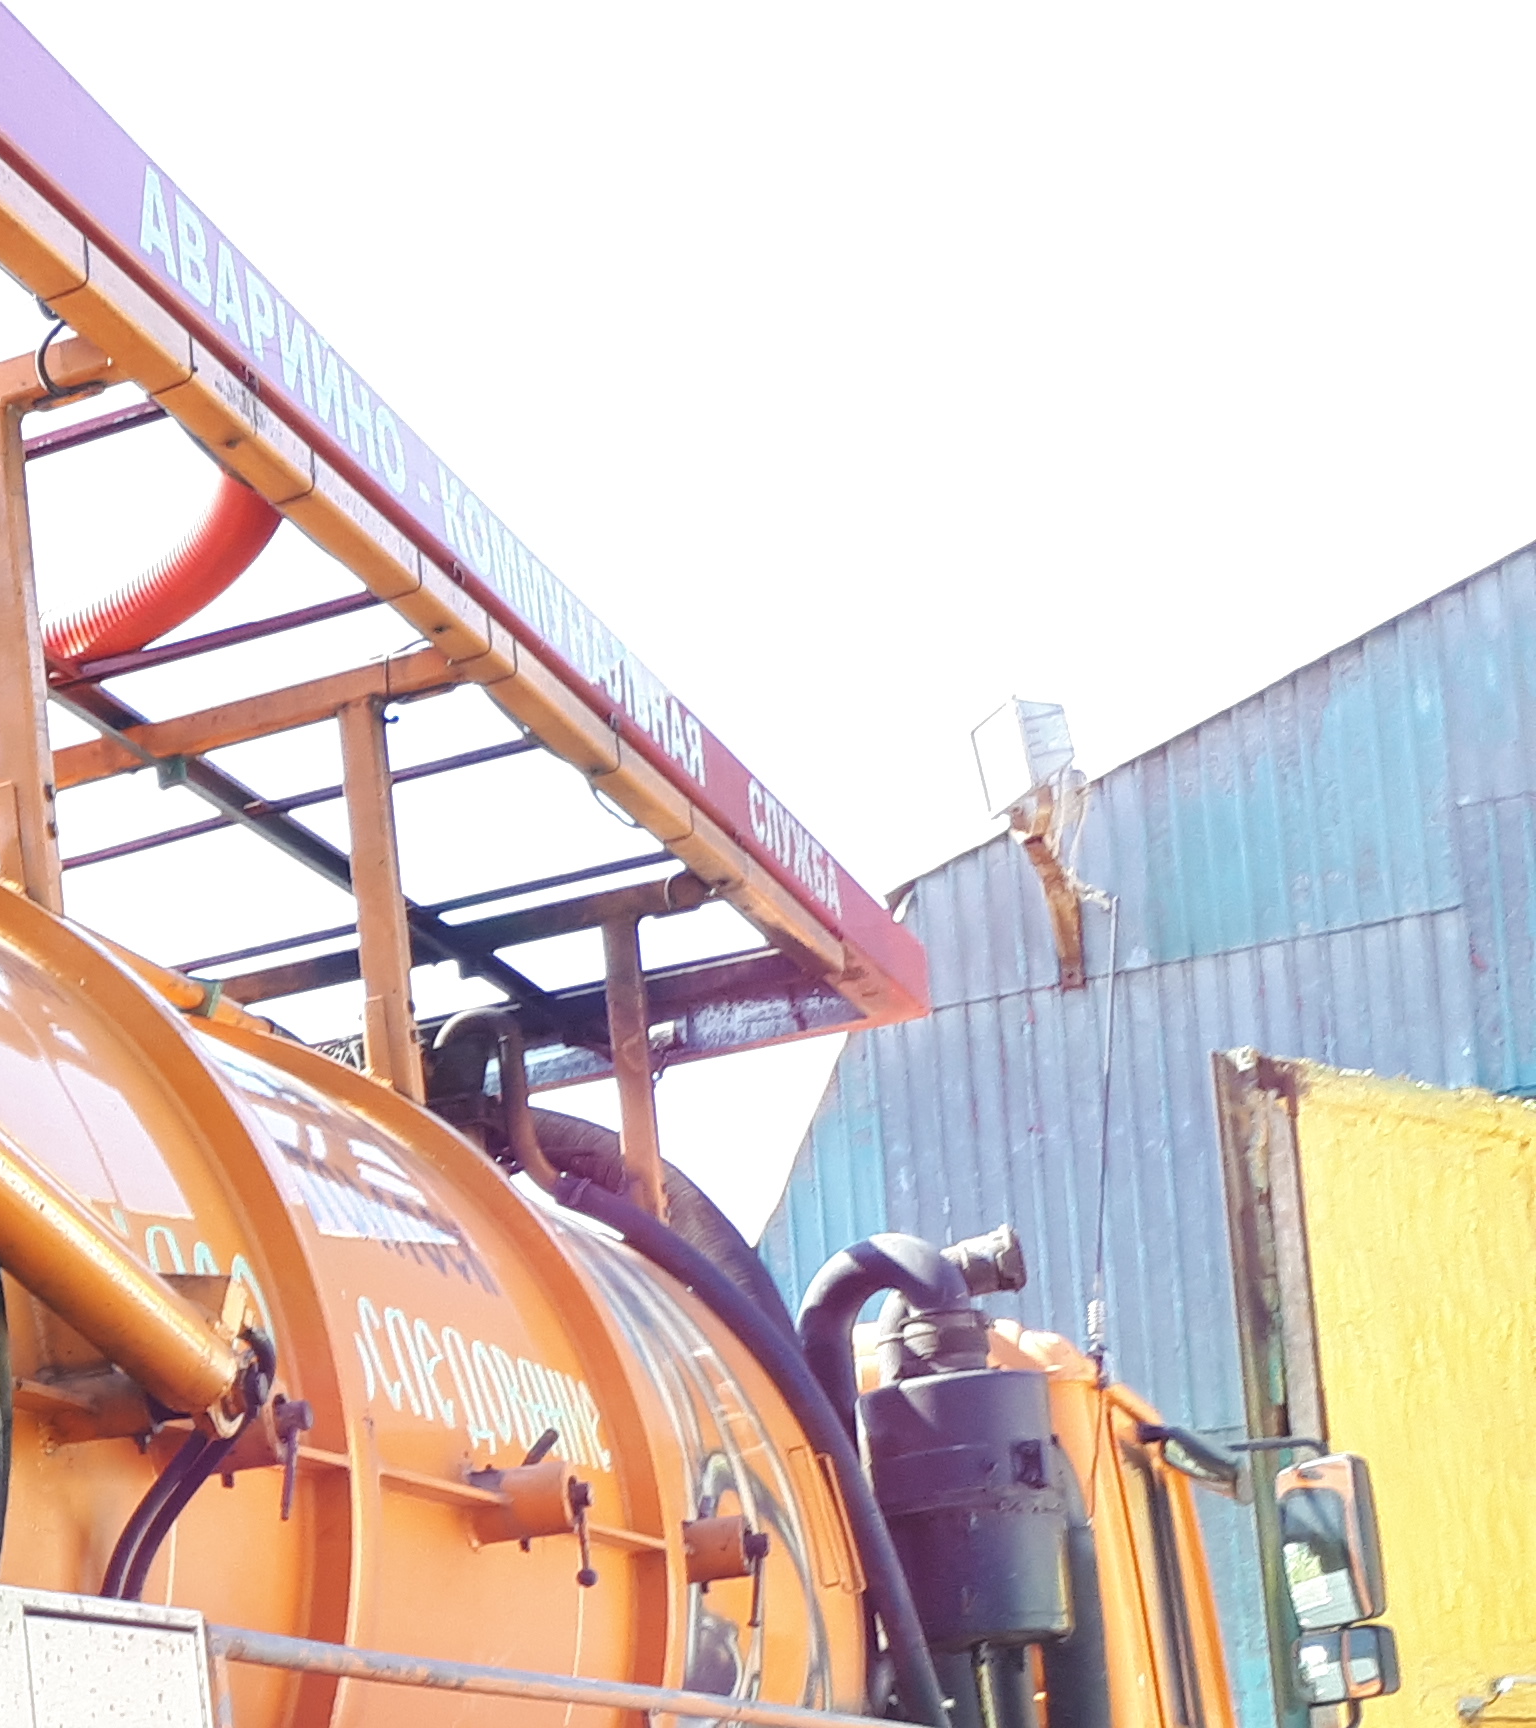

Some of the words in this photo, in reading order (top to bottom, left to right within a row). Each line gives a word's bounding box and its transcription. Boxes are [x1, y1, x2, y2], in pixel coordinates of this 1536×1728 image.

[140, 164, 406, 493] АВАРИЙНО
[438, 463, 705, 787] КОММУНАЛЬНАЯ
[748, 777, 842, 920] СЛУЖБА
